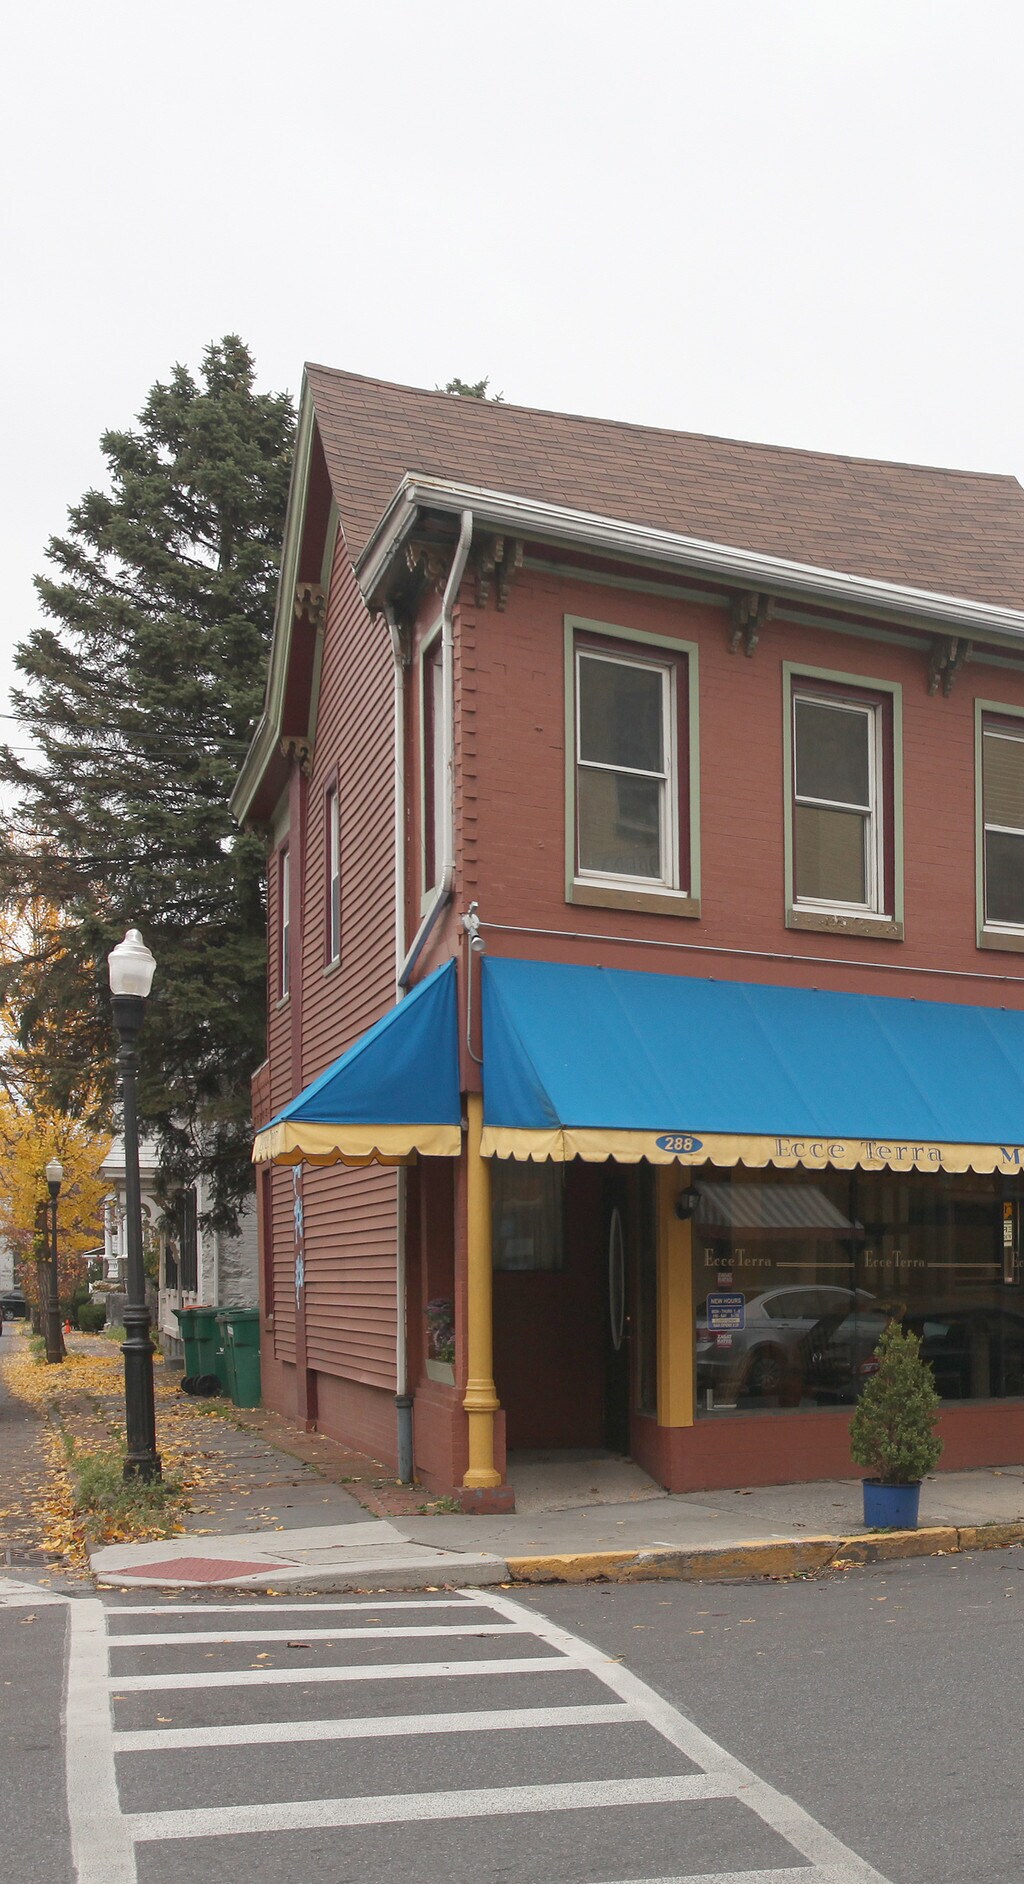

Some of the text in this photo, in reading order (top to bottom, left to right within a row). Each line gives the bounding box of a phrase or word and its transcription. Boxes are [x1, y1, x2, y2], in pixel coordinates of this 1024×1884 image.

[664, 1136, 693, 1151] 288
[774, 1138, 944, 1162] Ecce Terra
